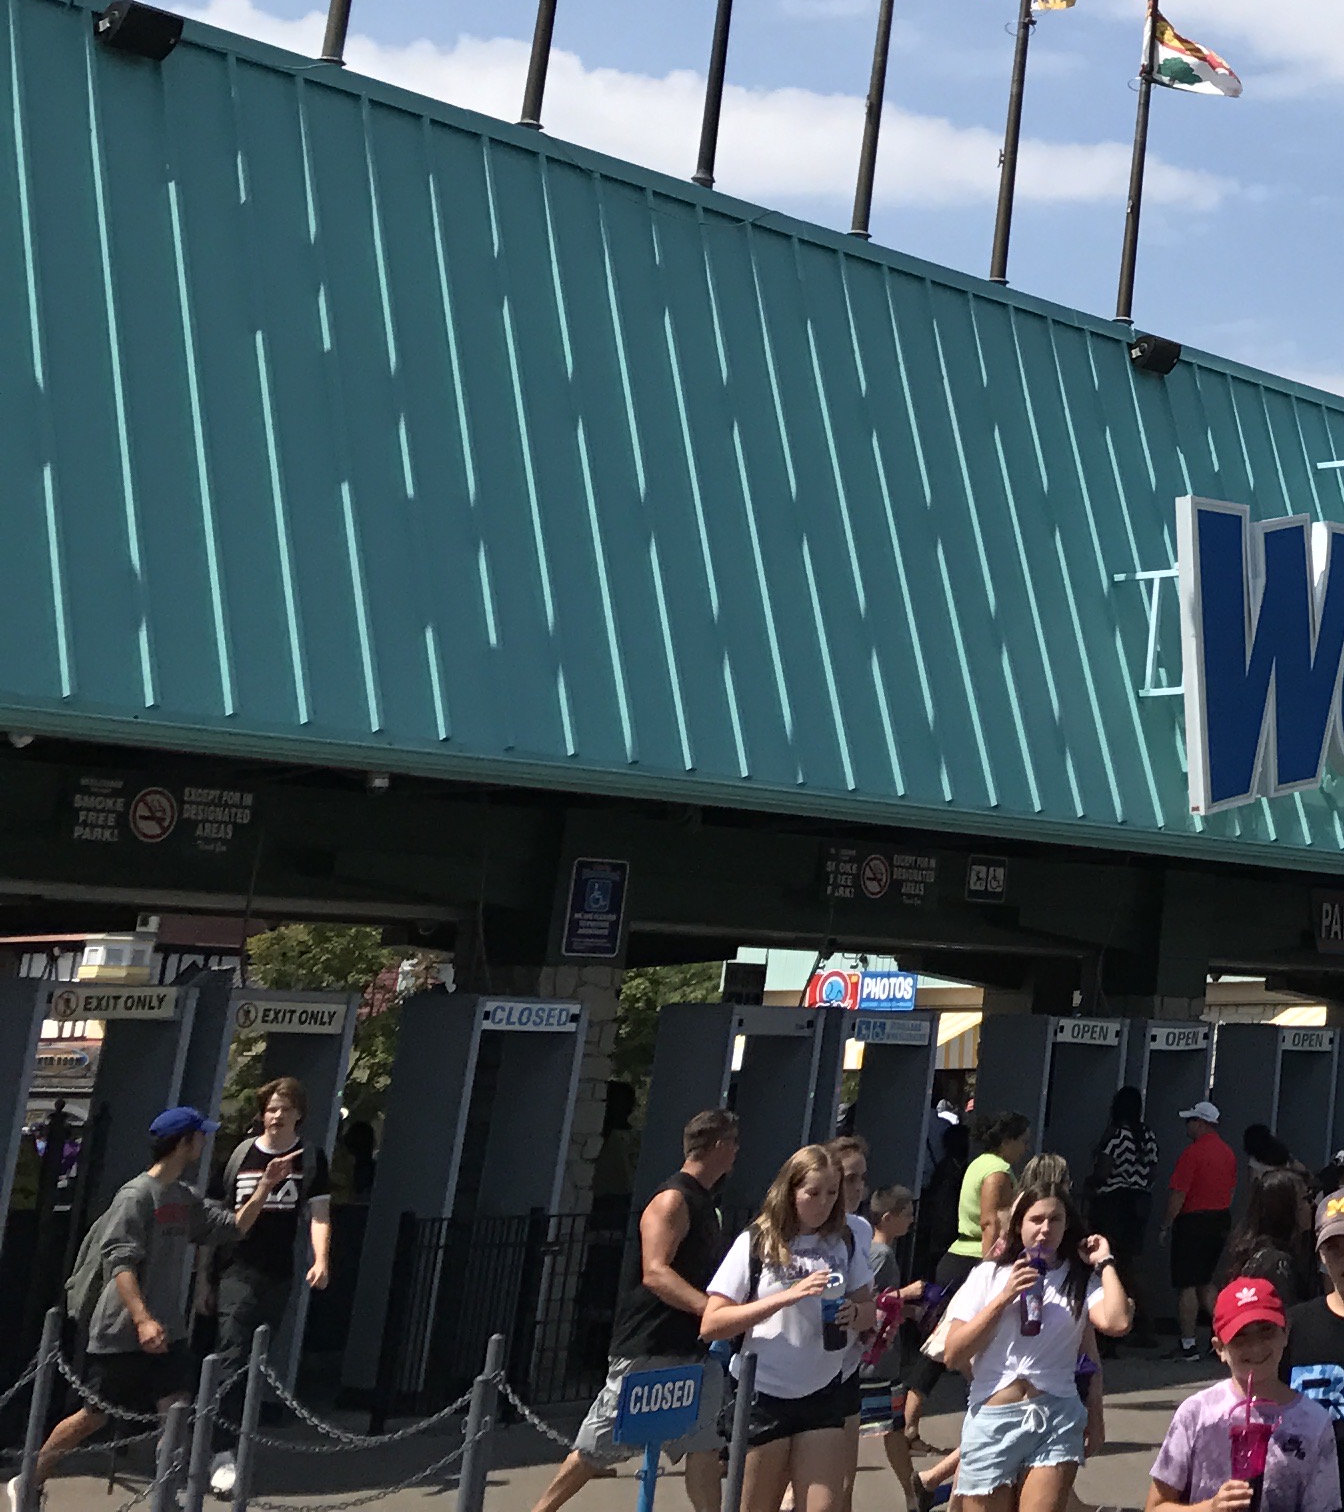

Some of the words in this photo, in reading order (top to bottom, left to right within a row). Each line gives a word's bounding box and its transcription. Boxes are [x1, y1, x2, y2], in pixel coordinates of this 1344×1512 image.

[74, 794, 124, 812] SMOKE
[184, 788, 220, 803] EXCEPT
[222, 791, 241, 805] FOR
[243, 793, 253, 807] IN
[79, 811, 117, 826] FREE
[183, 804, 250, 824] DESIGNATED
[74, 826, 119, 842] PARK!
[195, 823, 233, 839] AREAS
[862, 976, 914, 1000] PHOTOS
[83, 995, 121, 1013] EXIT
[122, 992, 168, 1012] ONLY
[260, 1008, 296, 1026] EXIT
[297, 1009, 338, 1027] ONLY
[490, 1005, 570, 1027] CLOSED
[1071, 1023, 1109, 1041] OPEN
[1165, 1031, 1199, 1047] OPEN
[1291, 1032, 1323, 1048] OPEN
[629, 1379, 695, 1415] CLOSED
